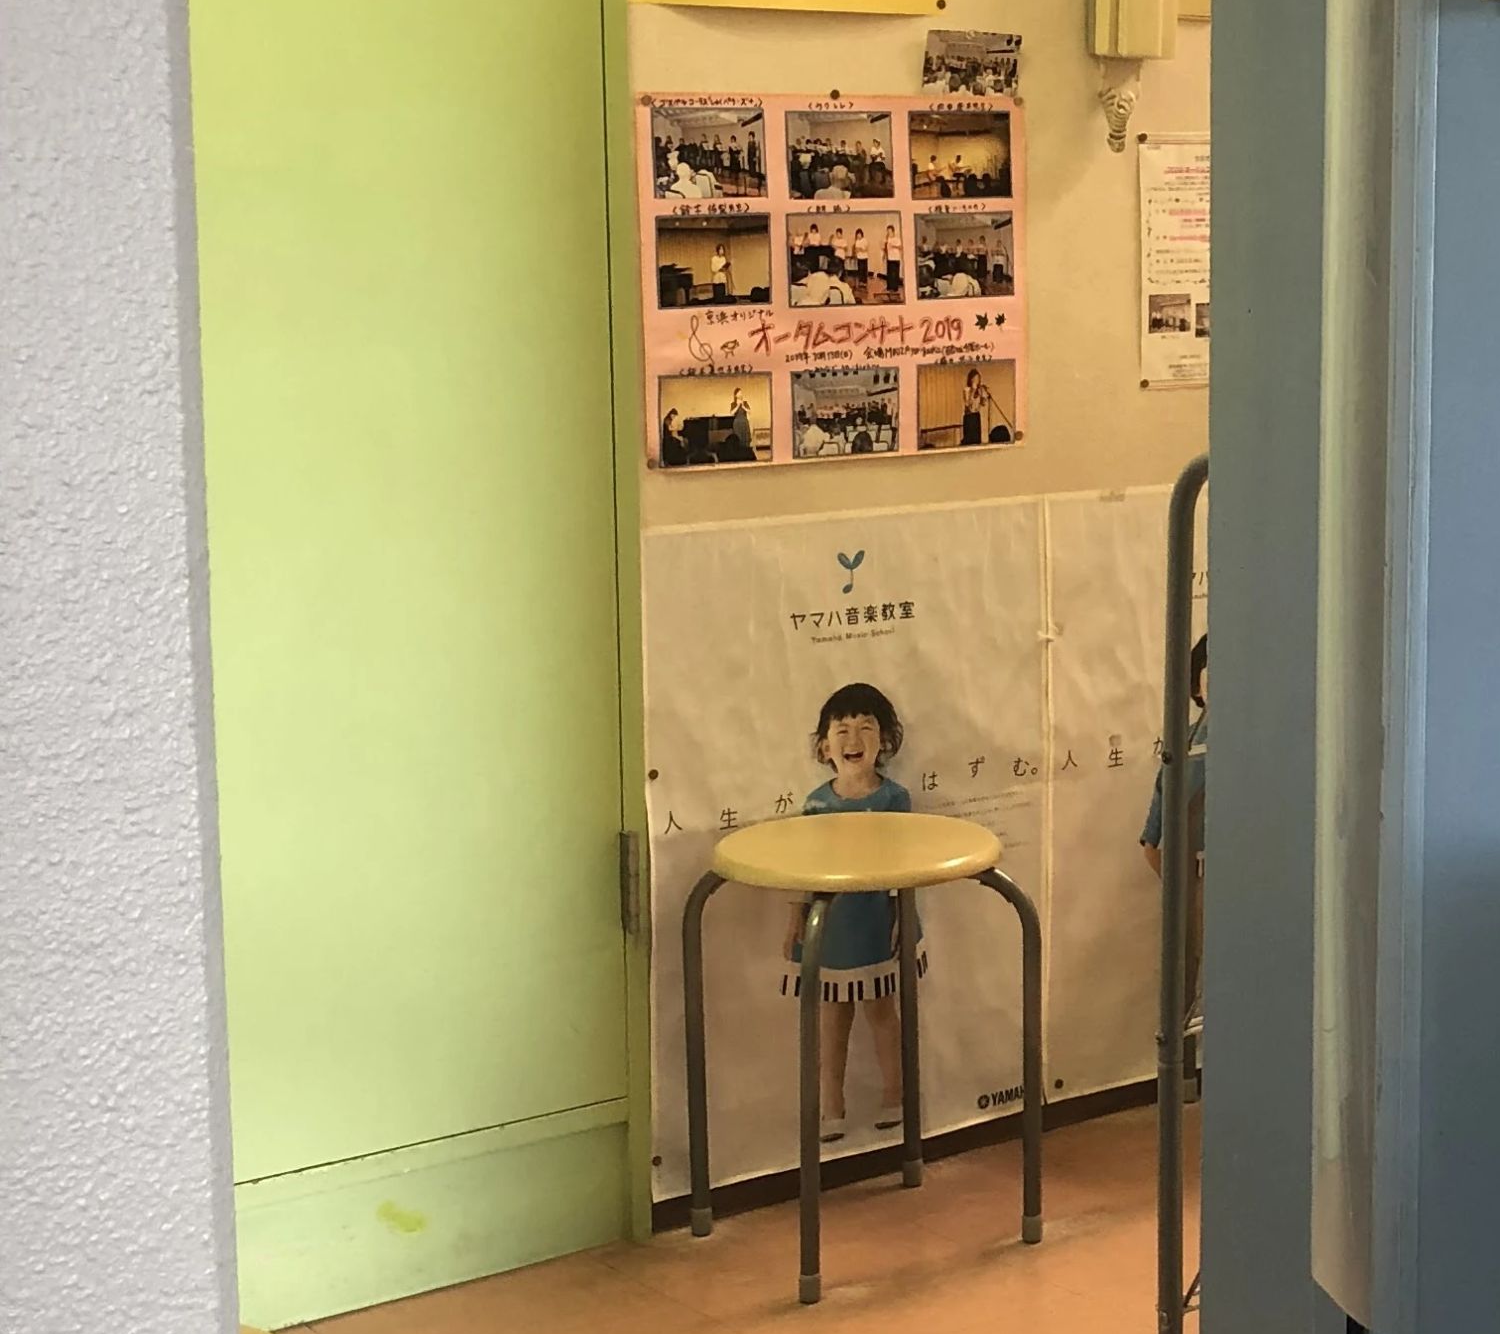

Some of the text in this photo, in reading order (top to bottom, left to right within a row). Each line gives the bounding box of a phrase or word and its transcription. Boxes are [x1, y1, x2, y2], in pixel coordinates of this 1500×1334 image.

[748, 315, 913, 356] オータムコンサート
[920, 315, 963, 344] 2019
[790, 600, 915, 630] ヤマハ音楽教室
[811, 634, 842, 644] Yamaha
[991, 1085, 1024, 1106] YAMA
